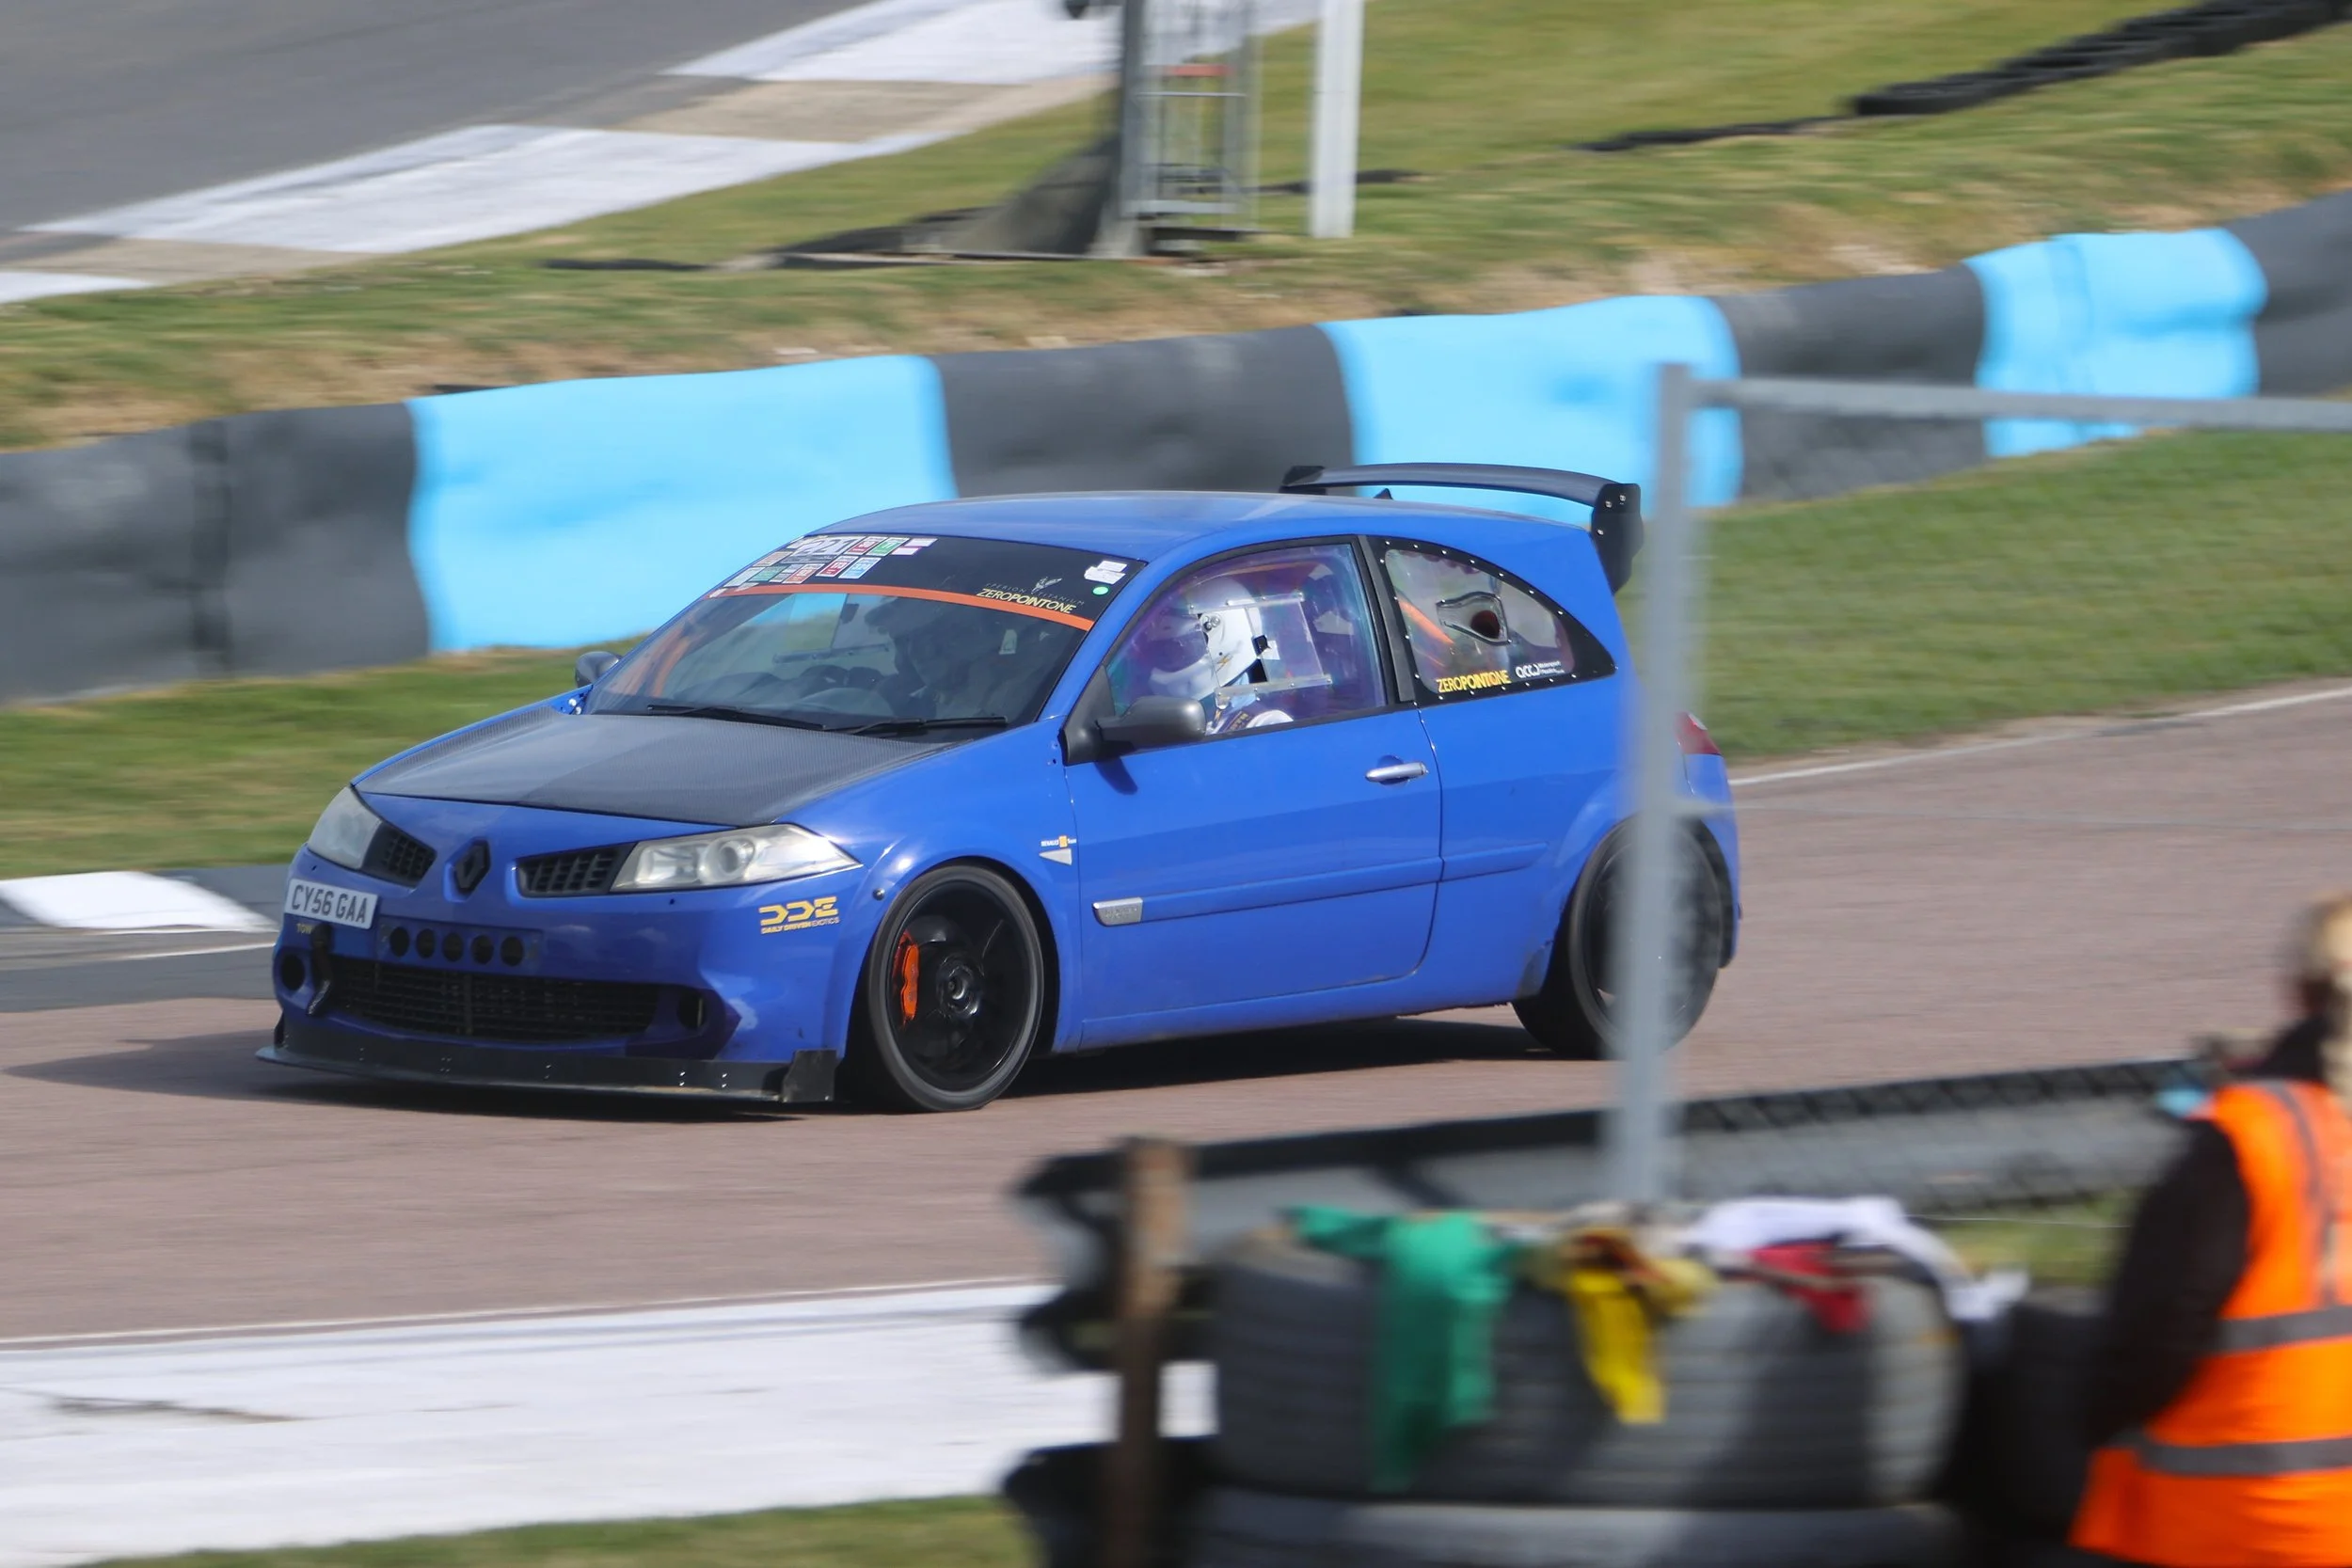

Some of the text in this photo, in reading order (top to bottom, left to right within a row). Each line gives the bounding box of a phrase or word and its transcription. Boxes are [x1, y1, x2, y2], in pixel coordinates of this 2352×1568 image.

[976, 588, 1077, 614] ZEROPOINTONE
[1436, 670, 1512, 693] ZEROPOINTONE
[292, 884, 368, 924] CY56 GAA
[760, 925, 784, 934] DAILY
